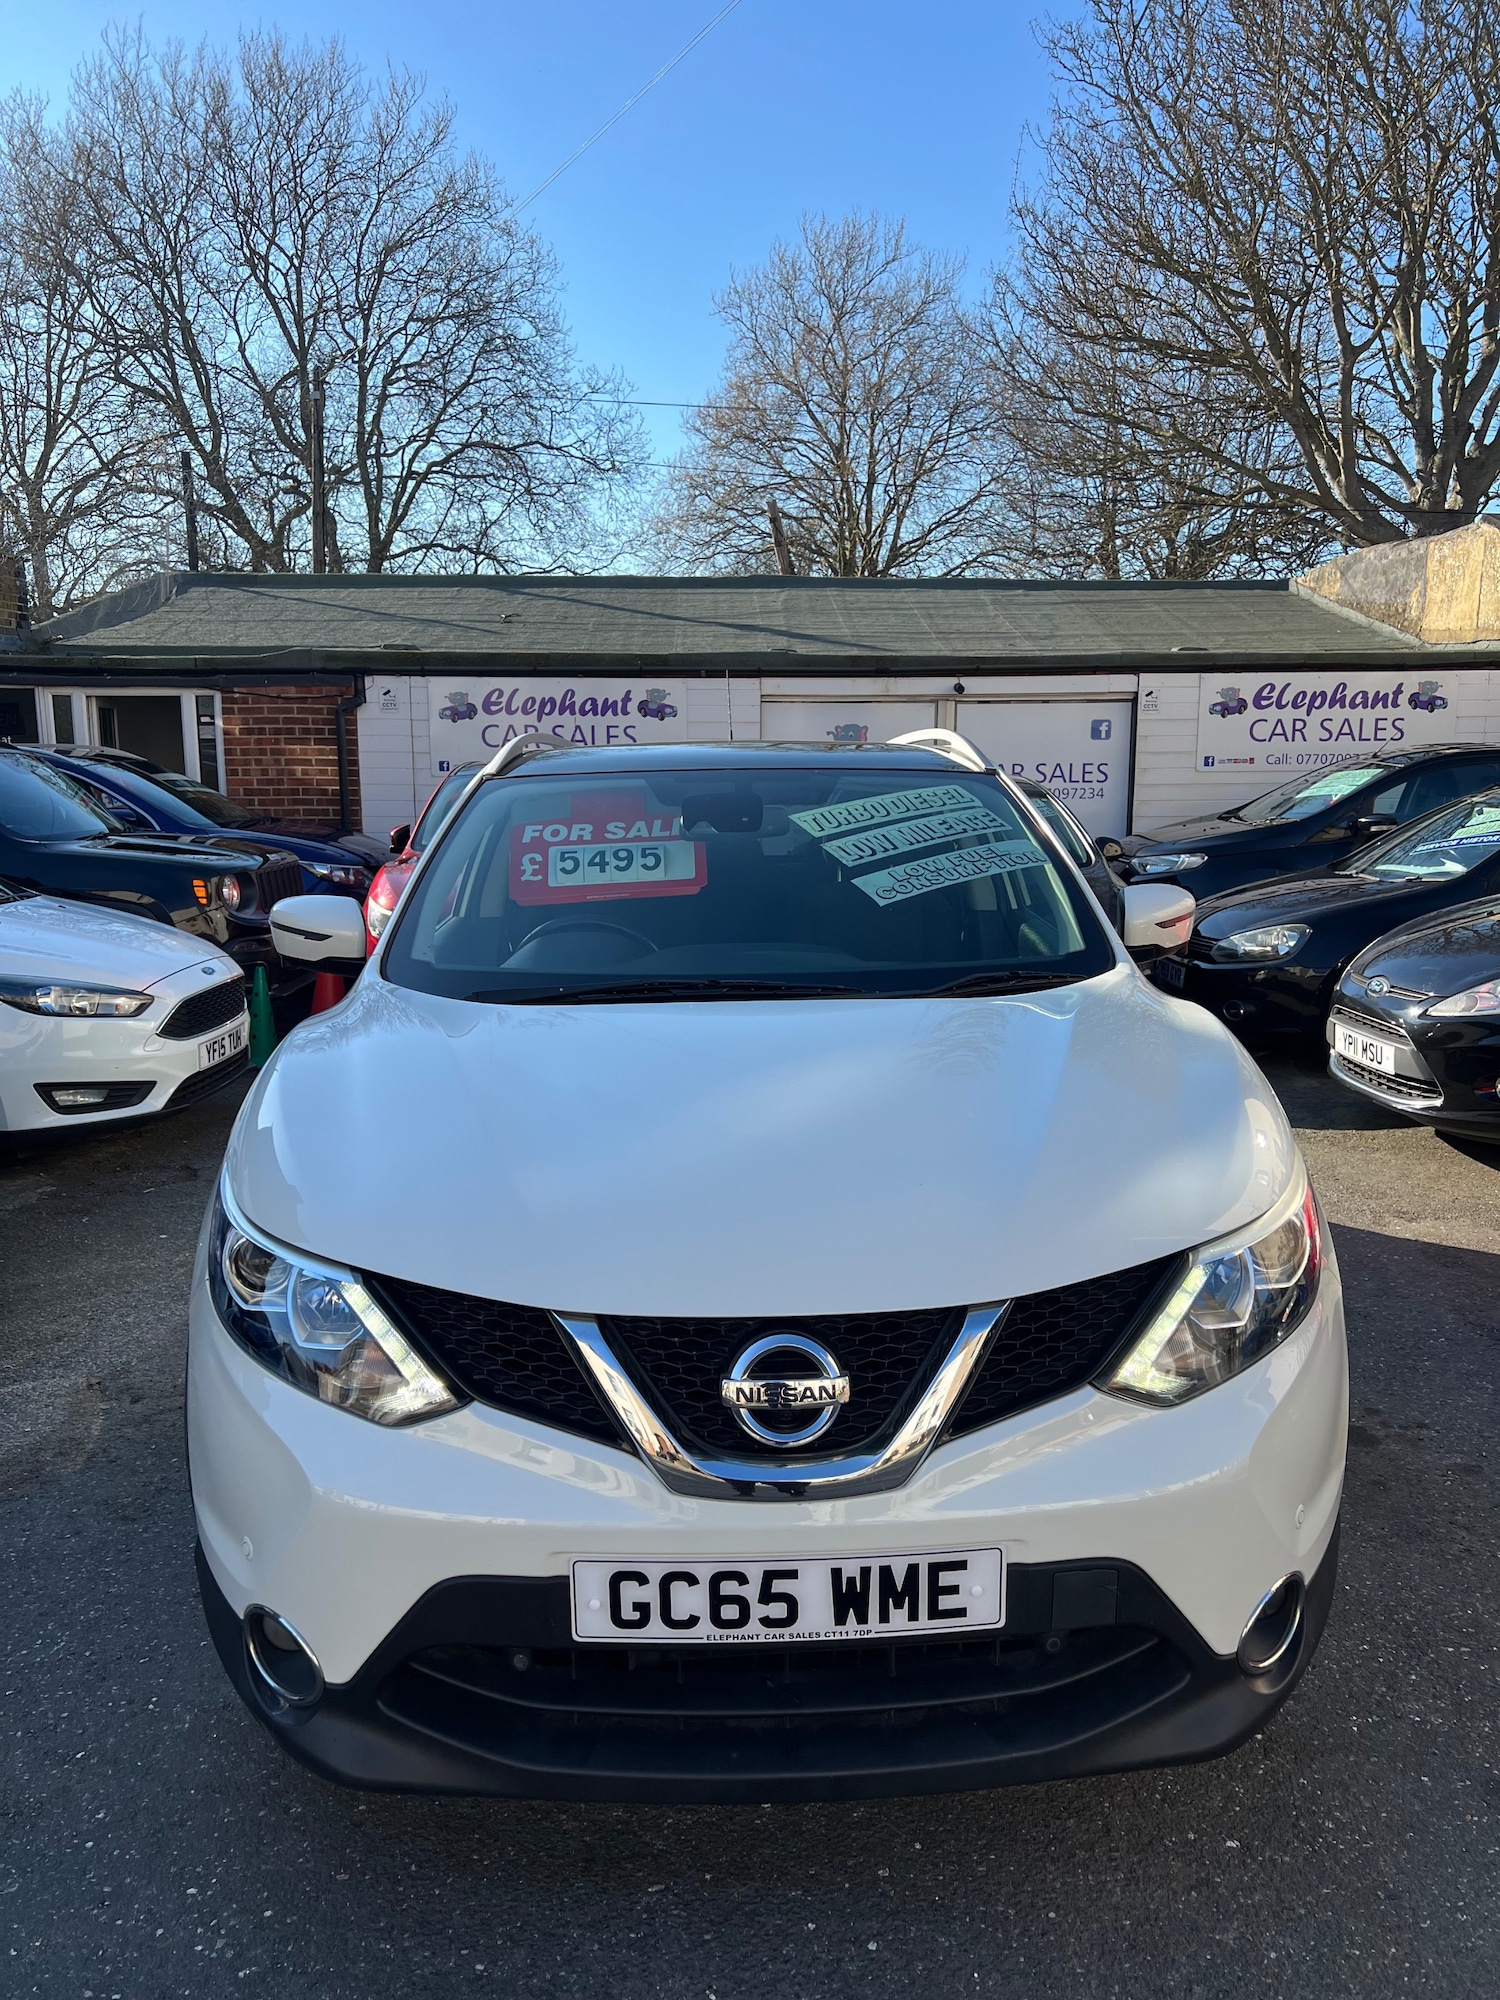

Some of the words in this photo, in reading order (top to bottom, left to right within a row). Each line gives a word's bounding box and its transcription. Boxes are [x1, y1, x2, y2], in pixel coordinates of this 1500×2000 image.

[482, 687, 633, 722] Elephant
[1252, 681, 1405, 716] Elephant
[1250, 718, 1307, 742] CAR
[1319, 717, 1405, 742] SALES
[1035, 763, 1109, 783] SALES
[1266, 753, 1292, 765] Call:
[800, 801, 890, 833] TURBO
[890, 787, 977, 815] DIESEL
[521, 823, 594, 844] FOR
[830, 831, 898, 863] LOW
[891, 809, 1004, 848] MILEAGE
[1416, 840, 1460, 852] SERVICE
[520, 853, 543, 882] £
[558, 847, 662, 875] 5495
[875, 850, 1048, 900] CONSUMPTION
[889, 857, 947, 882] LOW
[950, 845, 1011, 866] FUEL
[205, 1037, 226, 1063] YF15
[1343, 1031, 1358, 1056] YP11
[1361, 1040, 1383, 1065] MSU
[735, 1384, 837, 1403] NISSAN
[608, 1568, 800, 1630] GC65
[830, 1558, 969, 1627] WME
[706, 1633, 761, 1642] ELEPHANT
[788, 1631, 821, 1640] SALES
[824, 1630, 849, 1638] CT11
[853, 1629, 872, 1637] 7DP
